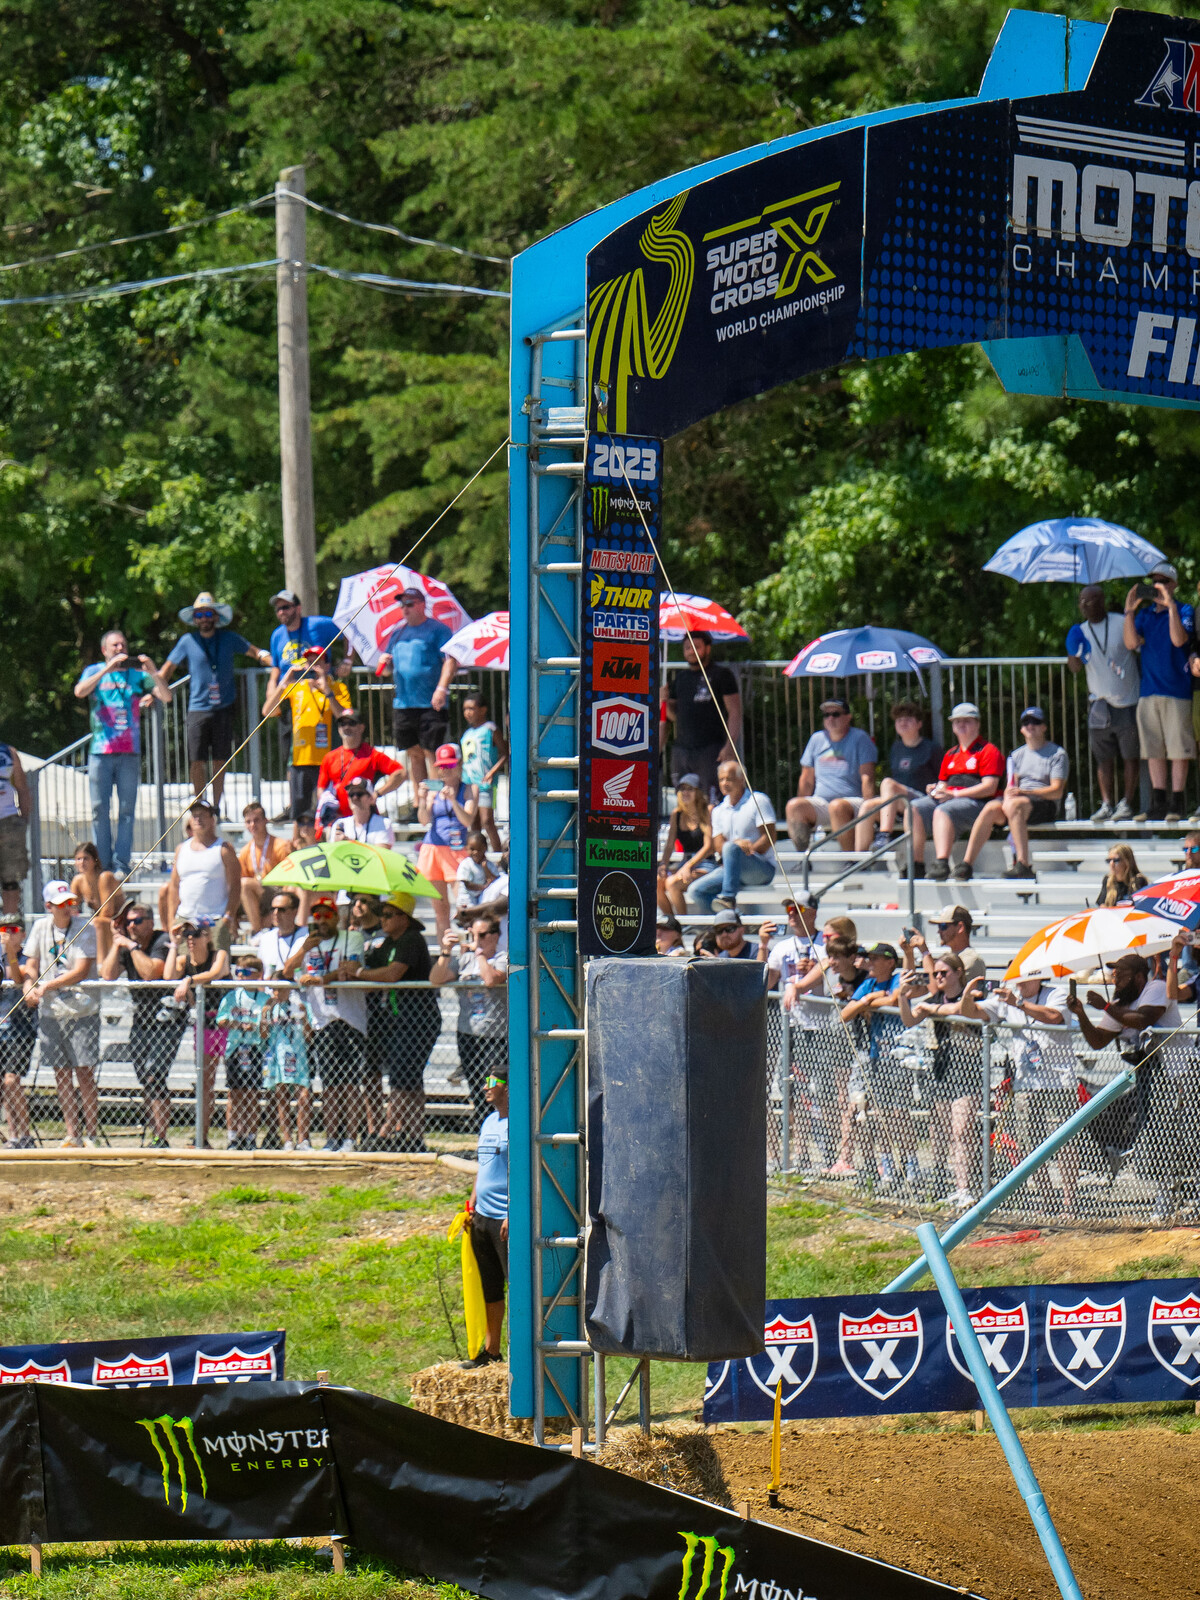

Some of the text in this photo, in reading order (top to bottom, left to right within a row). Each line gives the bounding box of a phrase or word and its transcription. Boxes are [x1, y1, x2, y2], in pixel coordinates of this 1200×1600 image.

[706, 228, 778, 271] SUPER
[713, 251, 777, 291] MOTO
[710, 272, 780, 315] CROSS
[716, 284, 846, 342] WORLD CHAMPIONSHIP
[1127, 311, 1200, 385] FI
[593, 444, 657, 481] 2023
[604, 586, 653, 609] THOR
[594, 612, 649, 630] PARTS
[594, 627, 649, 641] UNLIMITED
[601, 656, 641, 680] KTM
[600, 711, 642, 742] 100%
[603, 798, 636, 807] HONDA
[588, 815, 650, 827] INTENSE
[589, 843, 650, 862] Kawasaki
[971, 1314, 1021, 1327] ACER
[1053, 1311, 1119, 1324] RACER
[1156, 1306, 1200, 1319] RAC
[765, 1327, 810, 1340] ACER
[845, 1320, 914, 1335] RACER
[1067, 1328, 1104, 1370] X
[202, 1359, 267, 1372] RACER
[765, 1344, 802, 1386] X
[861, 1339, 902, 1381] X
[99, 1366, 164, 1379] RACER
[231, 1457, 324, 1472] ENERGY
